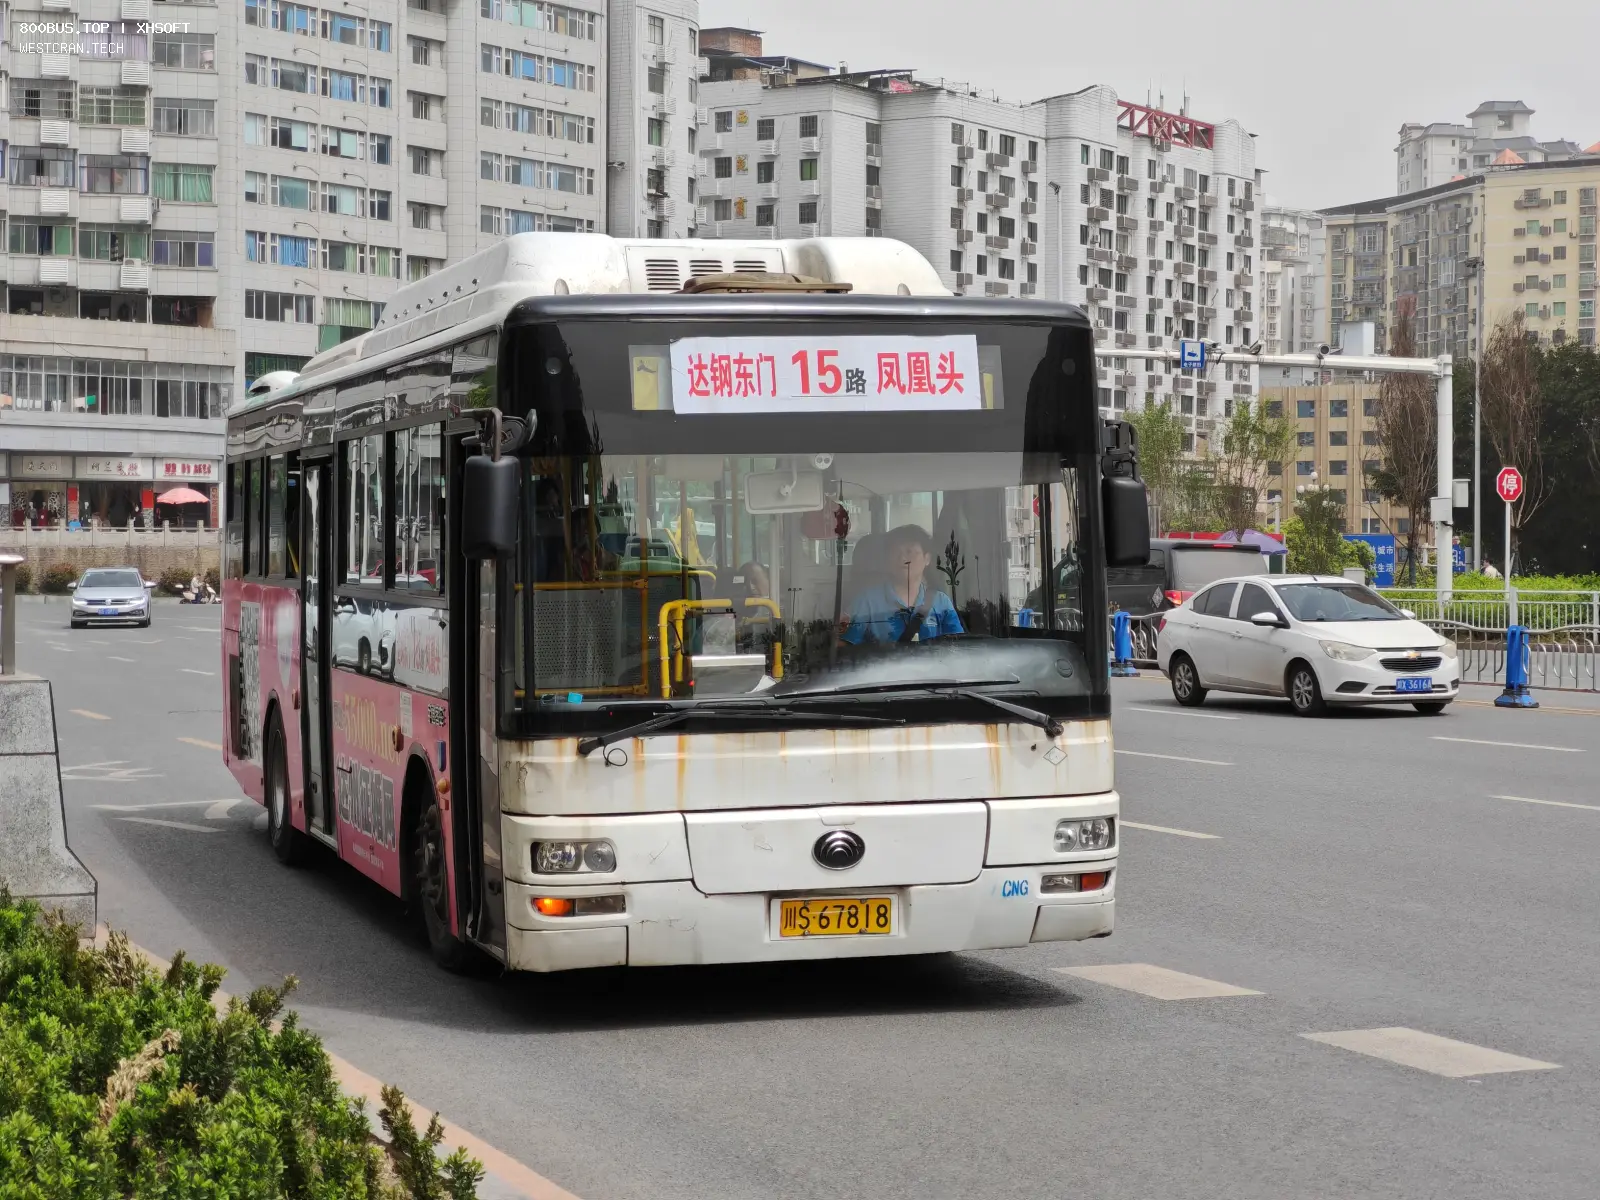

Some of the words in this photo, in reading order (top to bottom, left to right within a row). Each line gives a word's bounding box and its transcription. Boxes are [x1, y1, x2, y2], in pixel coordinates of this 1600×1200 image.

[687, 351, 777, 398] 达钢东门
[876, 350, 965, 396] 凤凰头
[1501, 473, 1518, 496] 停
[1001, 879, 1029, 897] CNG
